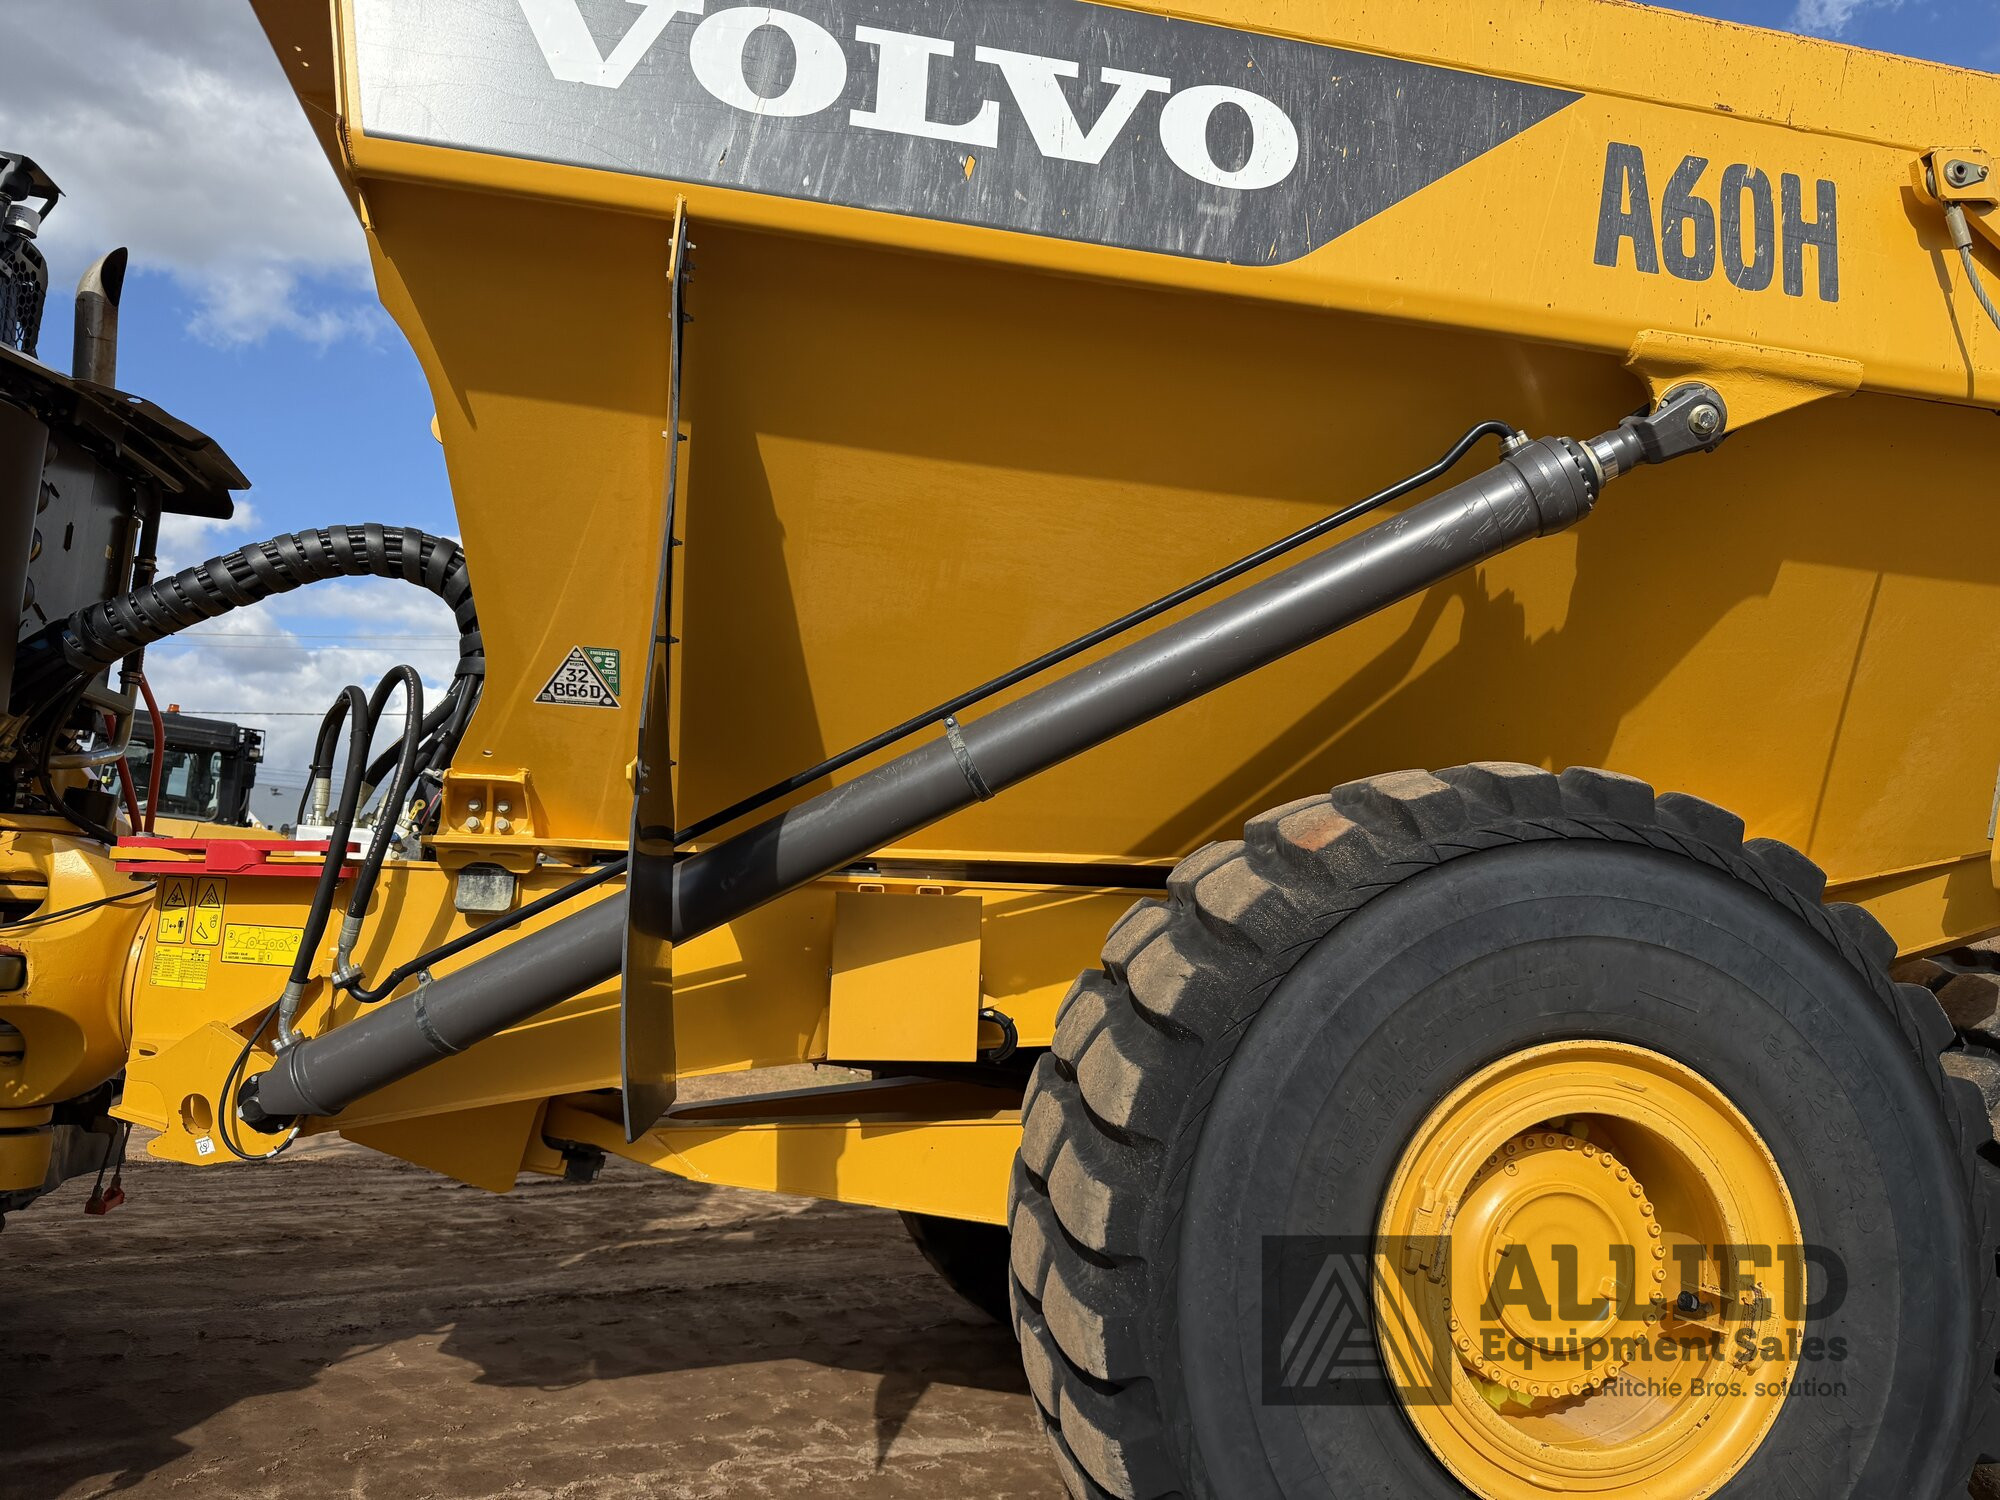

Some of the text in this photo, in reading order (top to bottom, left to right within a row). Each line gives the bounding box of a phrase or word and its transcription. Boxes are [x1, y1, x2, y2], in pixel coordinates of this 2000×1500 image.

[514, 0, 1300, 190] VOLVO
[1593, 141, 1839, 303] A60H
[604, 657, 616, 669] 5
[566, 668, 589, 683] 32
[553, 683, 601, 698] BG6D
